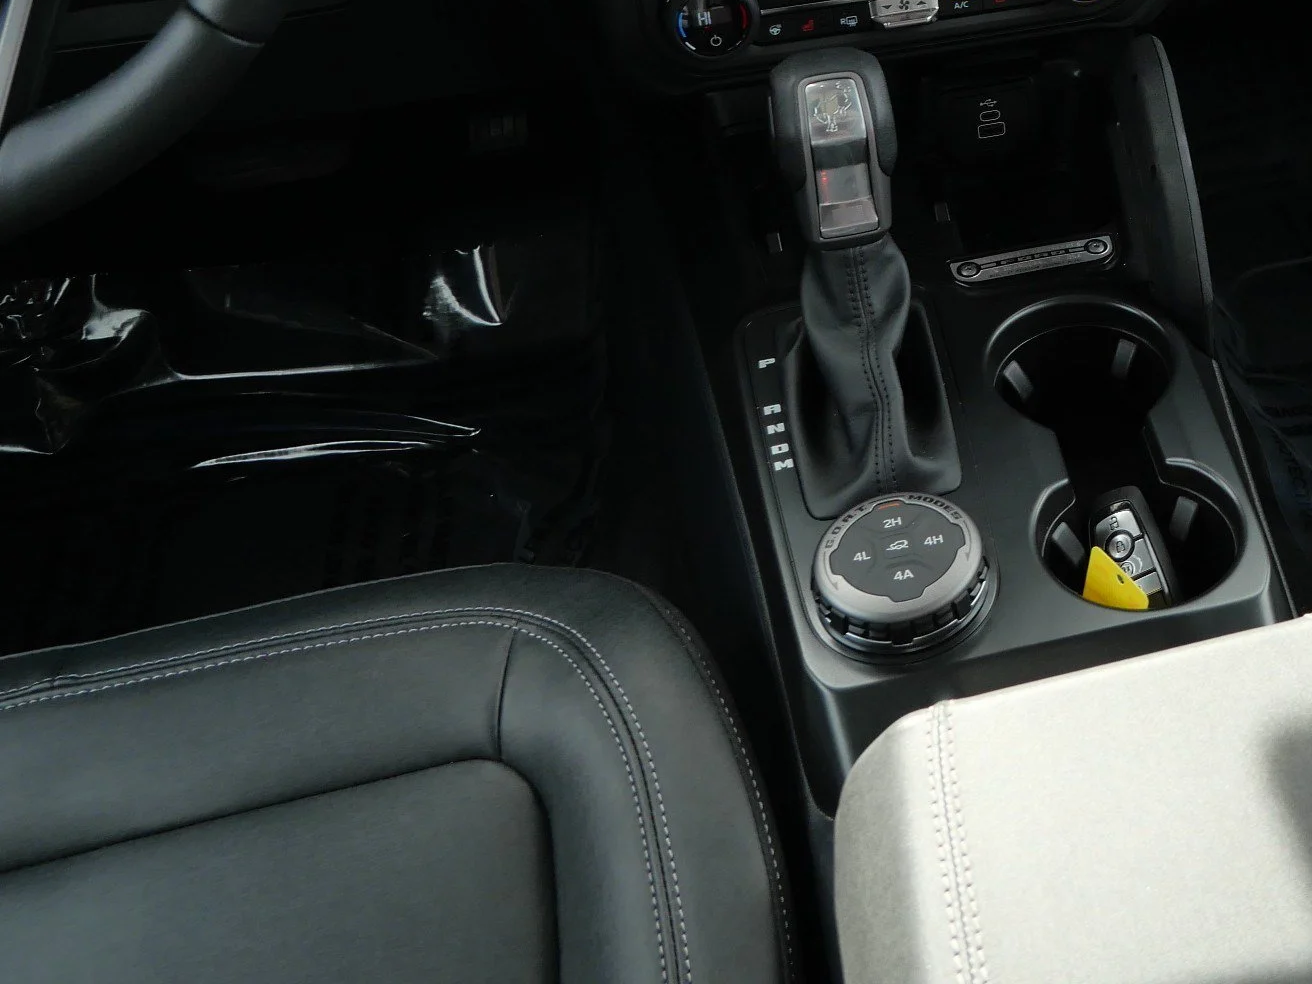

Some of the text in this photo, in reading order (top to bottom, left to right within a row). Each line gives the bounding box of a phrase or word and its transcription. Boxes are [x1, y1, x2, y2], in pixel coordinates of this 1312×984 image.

[954, 0, 969, 9] A/C
[758, 358, 776, 369] P
[767, 422, 785, 434] N
[770, 443, 789, 455] D
[774, 458, 794, 471] M
[906, 494, 963, 520] MODES
[883, 517, 902, 529] 2H
[923, 534, 944, 546] 4H
[853, 551, 872, 562] 4L
[893, 569, 914, 581] 4A
